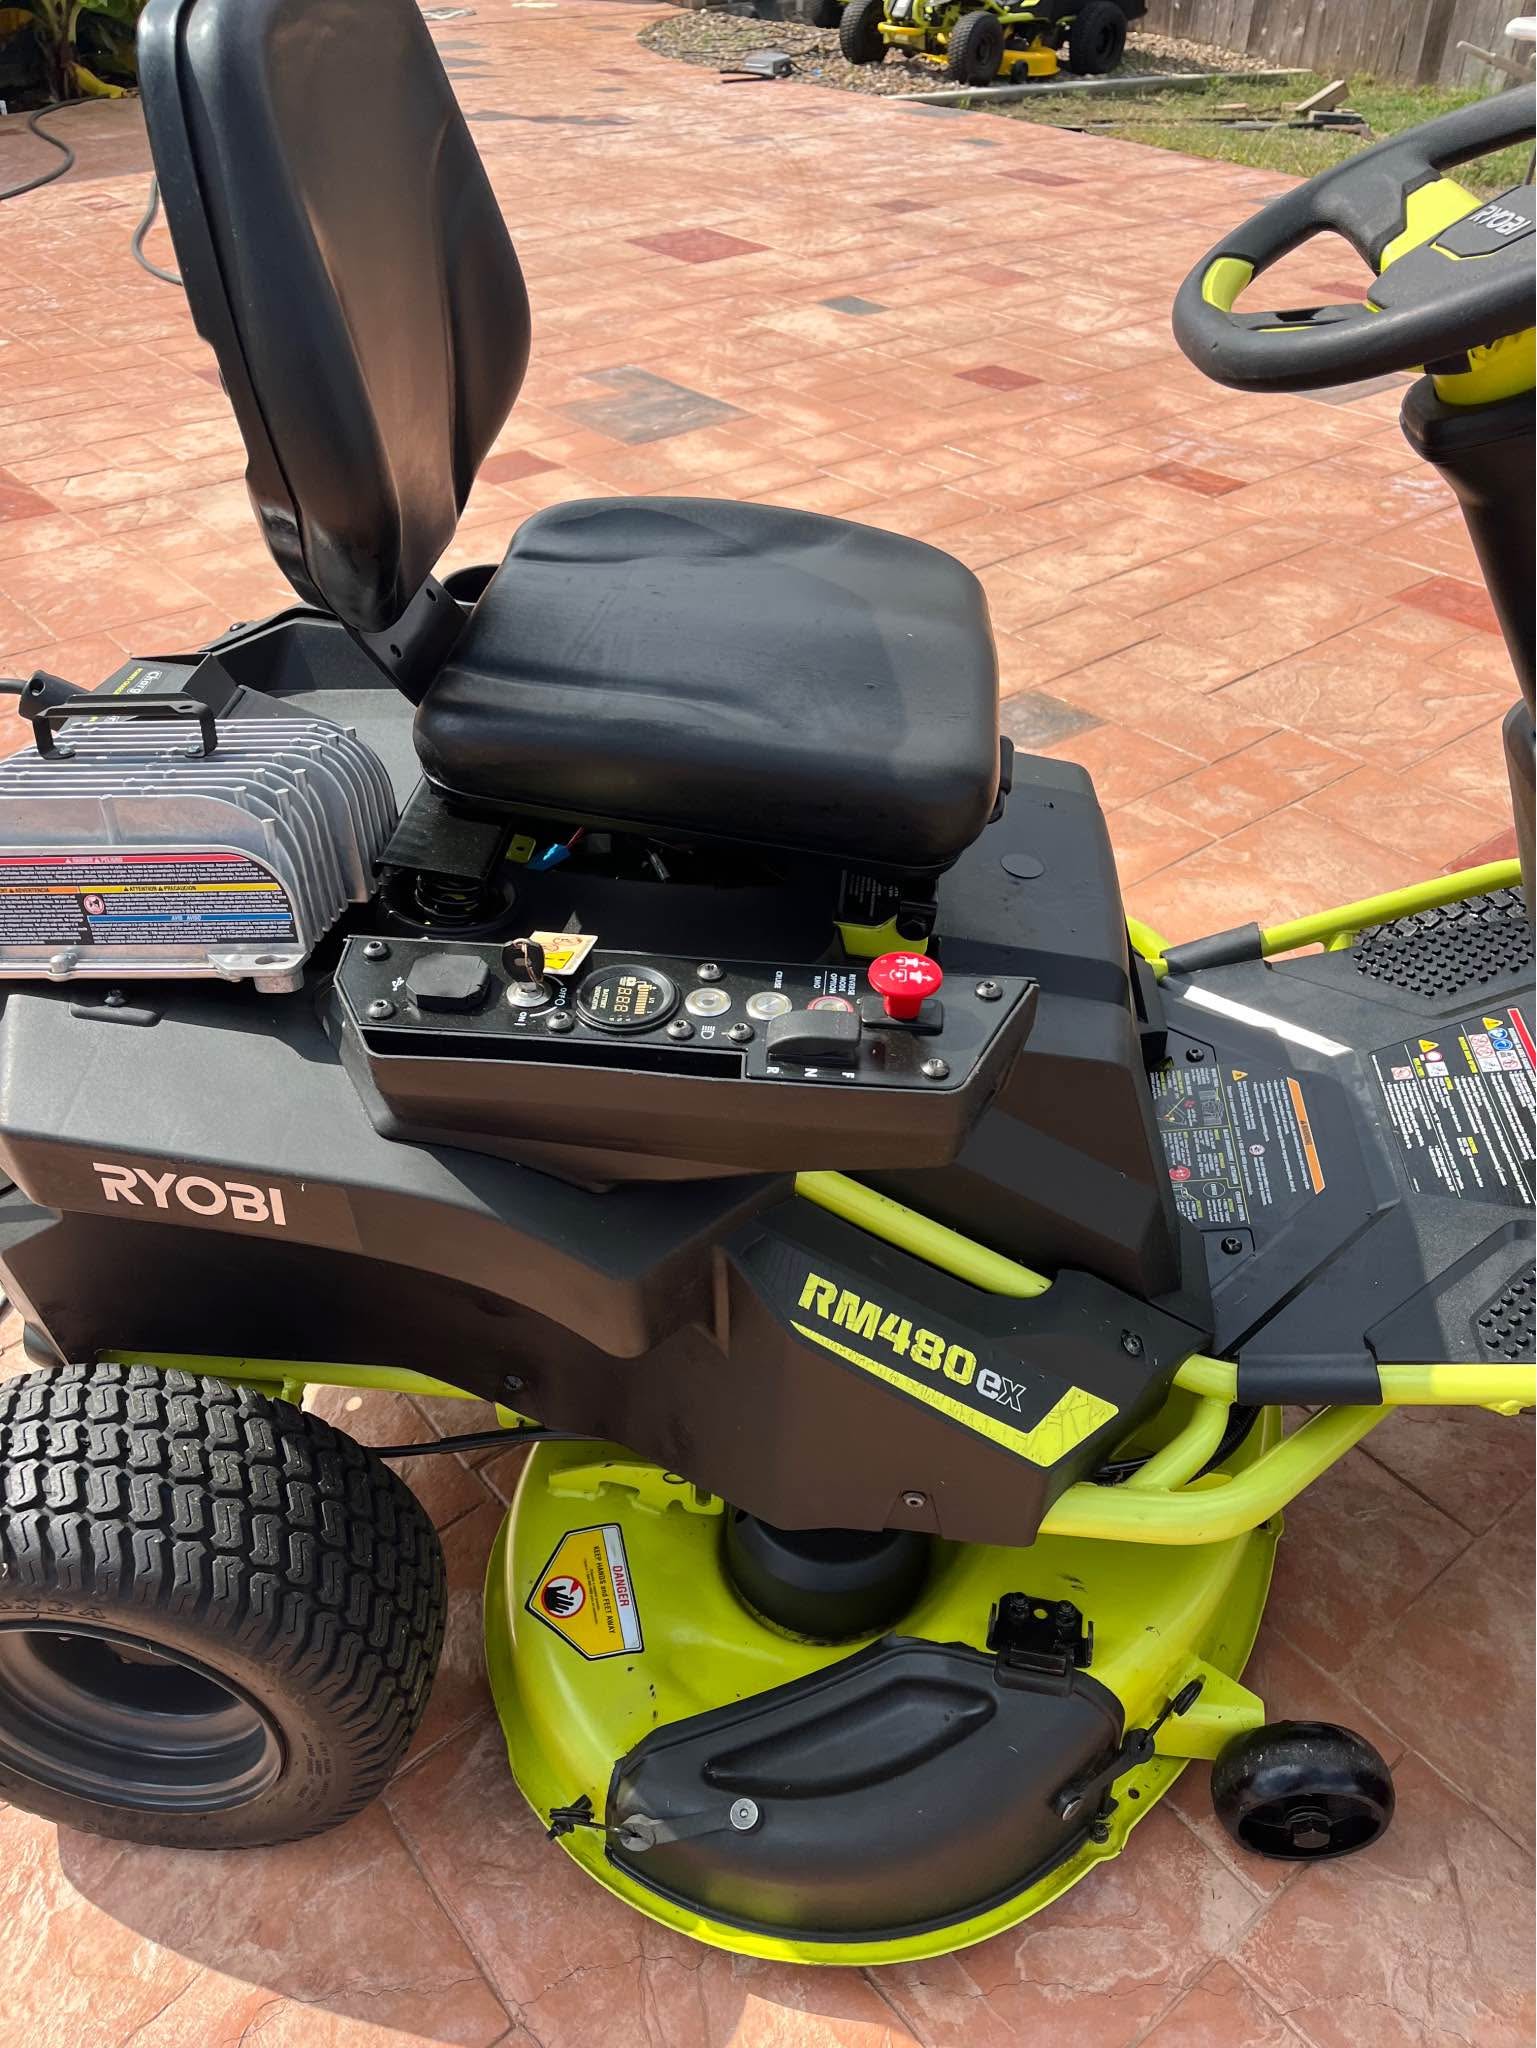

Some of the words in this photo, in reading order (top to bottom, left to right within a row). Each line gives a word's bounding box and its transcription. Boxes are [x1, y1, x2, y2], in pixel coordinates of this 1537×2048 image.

[1469, 205, 1533, 236] RYOBI
[127, 671, 162, 694] Charg
[559, 987, 568, 998] OFF
[829, 973, 838, 994] OPTION
[847, 974, 857, 996] REVERSE
[518, 1011, 527, 1022] ON
[766, 1066, 780, 1074] R
[804, 1067, 818, 1078] N
[841, 1071, 855, 1079] F
[92, 1162, 287, 1226] RYOBI
[797, 1272, 1026, 1413] RM480ex
[593, 1545, 602, 1561] KEEP
[597, 1562, 607, 1585] HANDS
[612, 1565, 630, 1607] DANGER
[603, 1598, 612, 1613] FEET
[607, 1615, 616, 1634] AWAY
